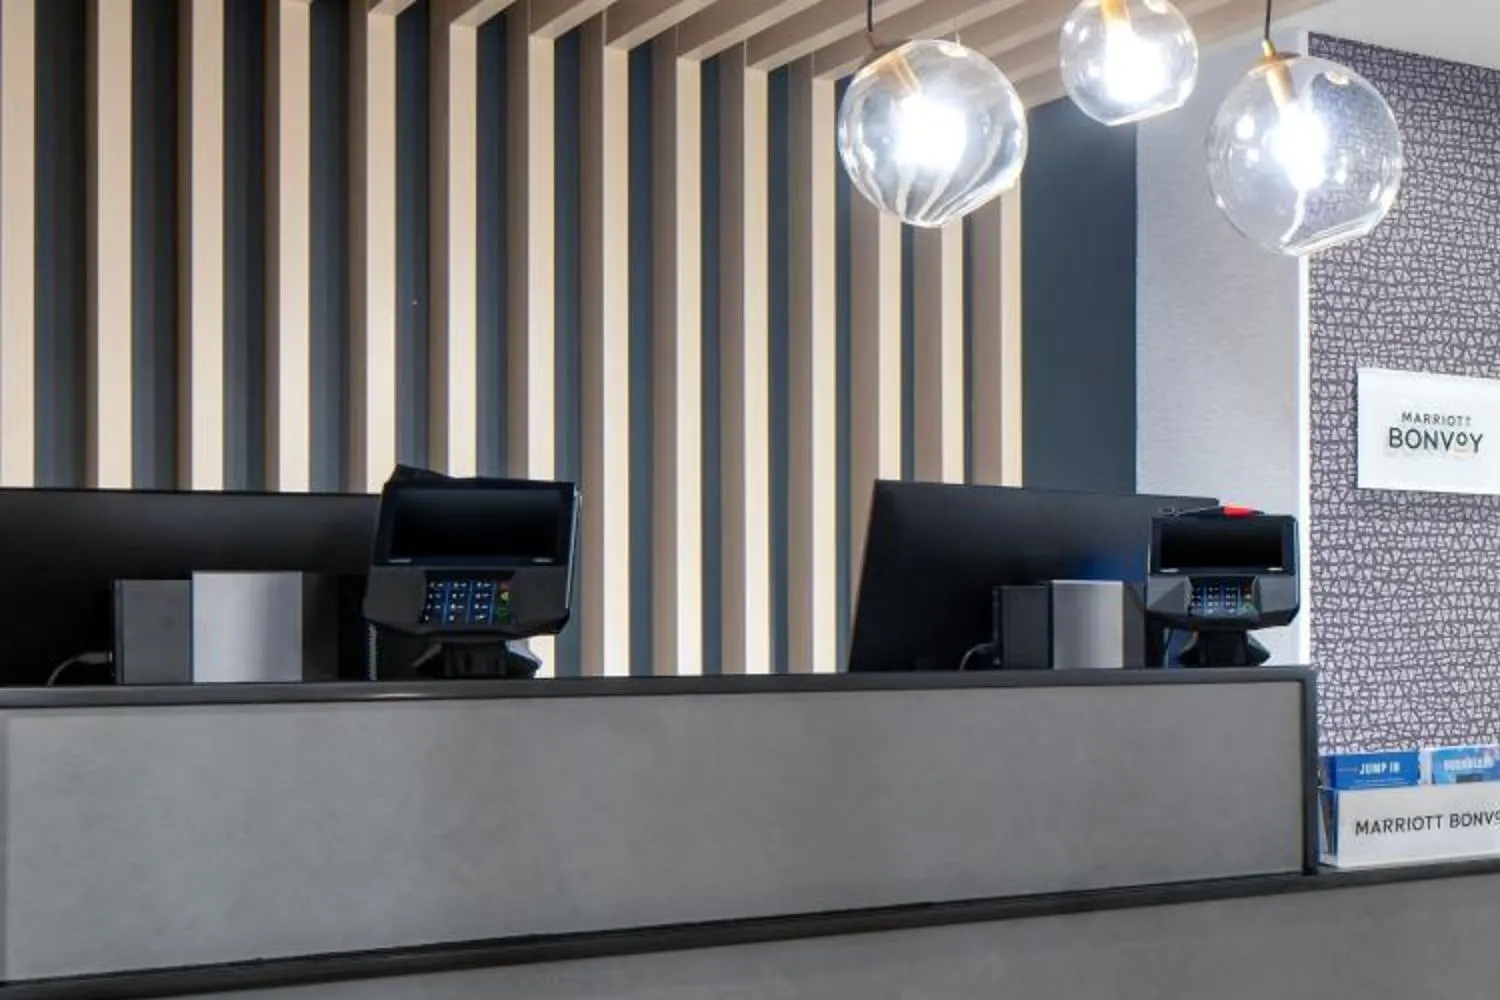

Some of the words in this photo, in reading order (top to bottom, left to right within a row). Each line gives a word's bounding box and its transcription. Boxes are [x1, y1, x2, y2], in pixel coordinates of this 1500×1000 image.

[1401, 411, 1471, 426] MARRIOTT
[1388, 426, 1483, 453] BONVOY
[1359, 761, 1387, 775] JUMP
[1355, 814, 1443, 836] MARRIOTT
